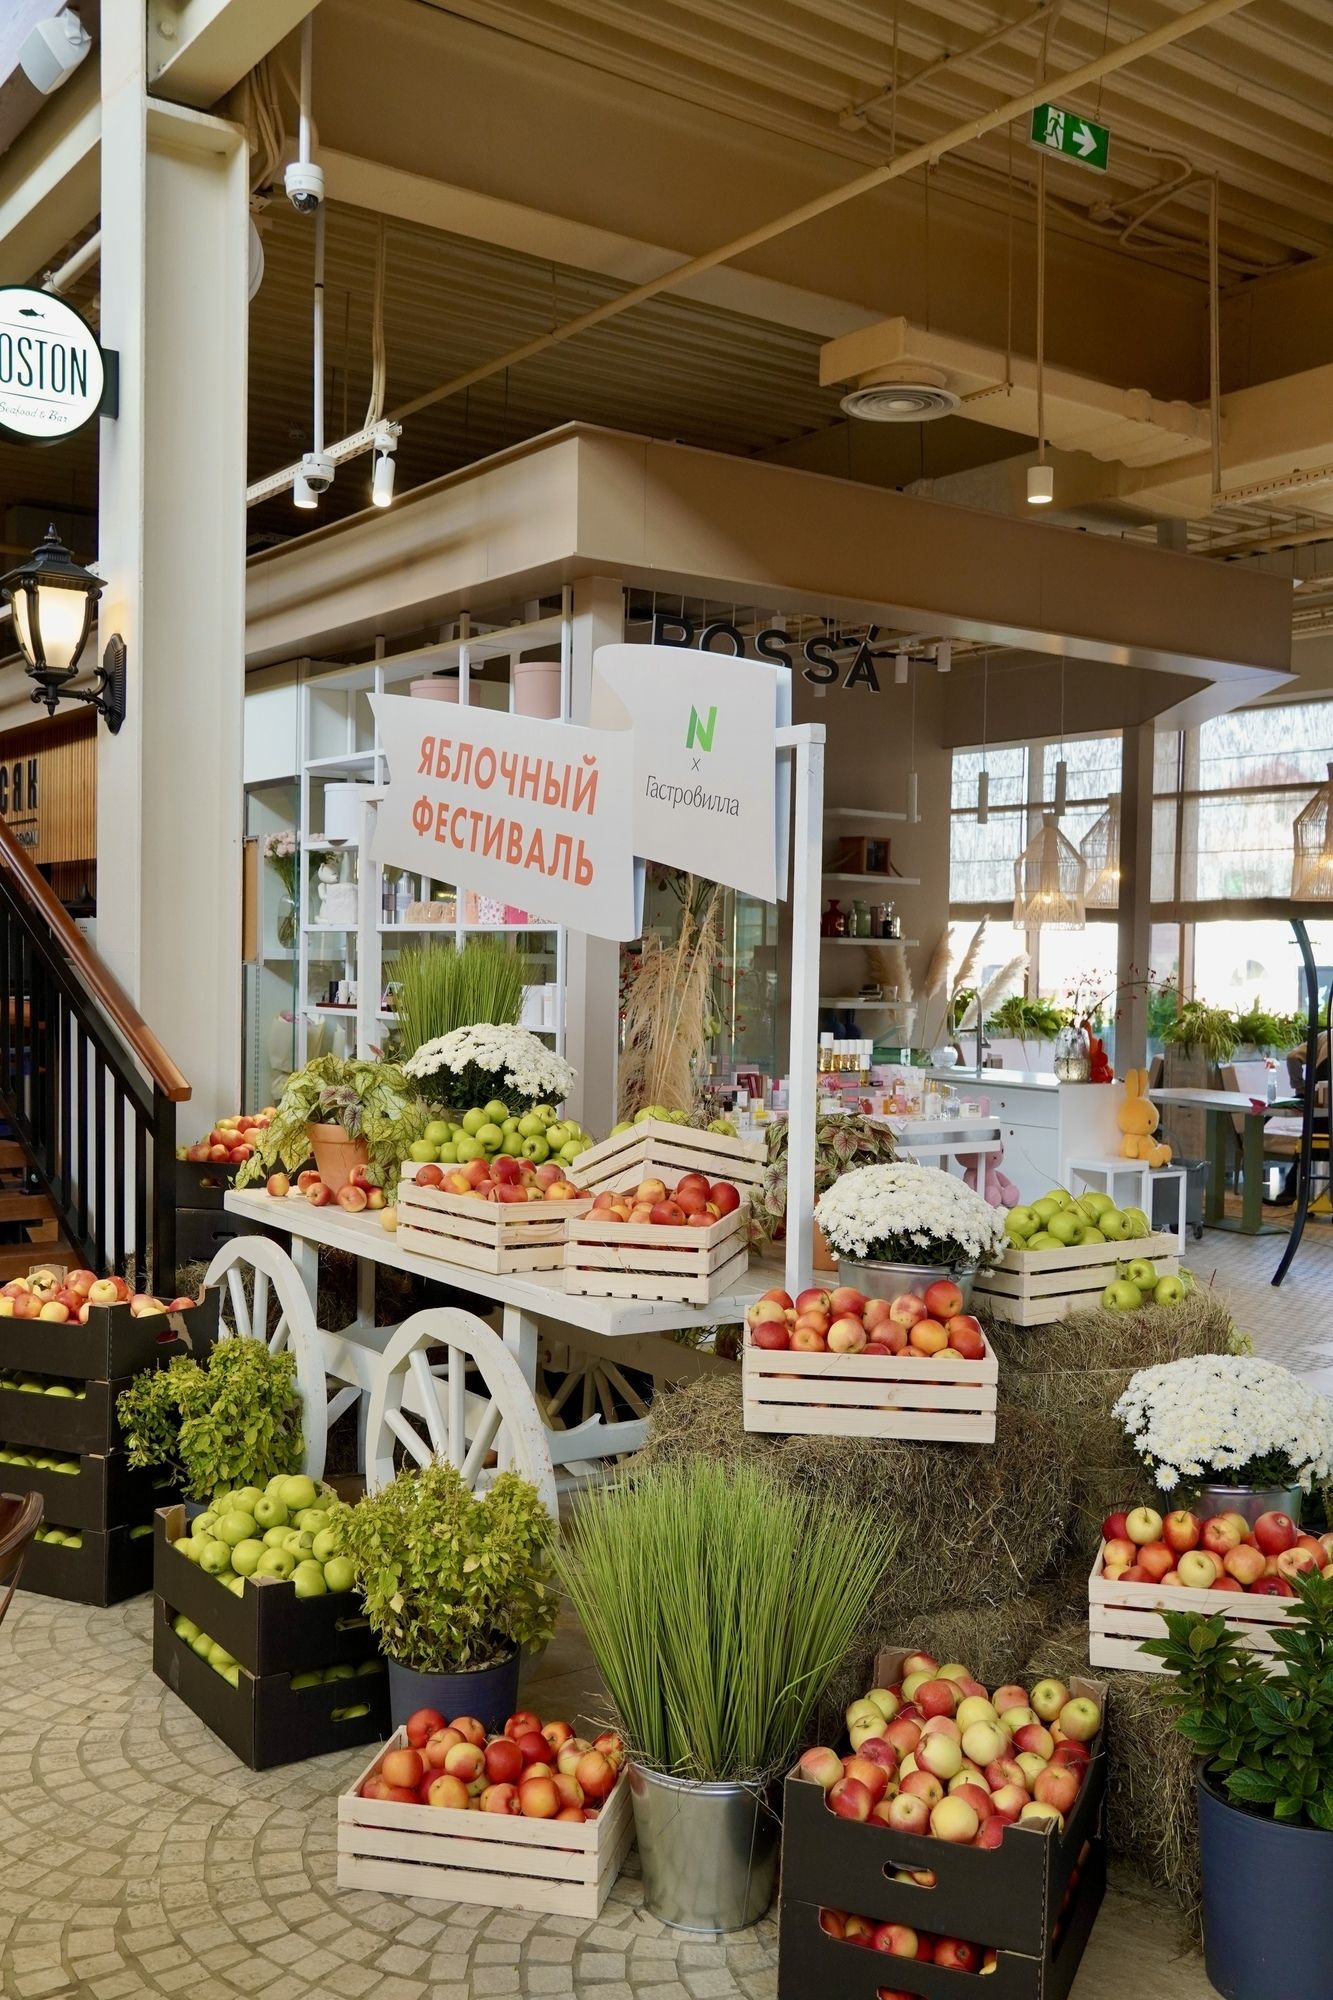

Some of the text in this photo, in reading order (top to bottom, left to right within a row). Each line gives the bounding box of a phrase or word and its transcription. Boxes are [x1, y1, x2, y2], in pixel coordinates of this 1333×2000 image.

[0, 333, 87, 398] OSTON
[48, 410, 68, 422] Bar
[686, 704, 718, 752] N
[417, 735, 599, 815] ЯБЛОЧНЫЙ
[646, 775, 740, 817] Гастровилла
[412, 795, 594, 886] ФЕСТИВАЛЬ
